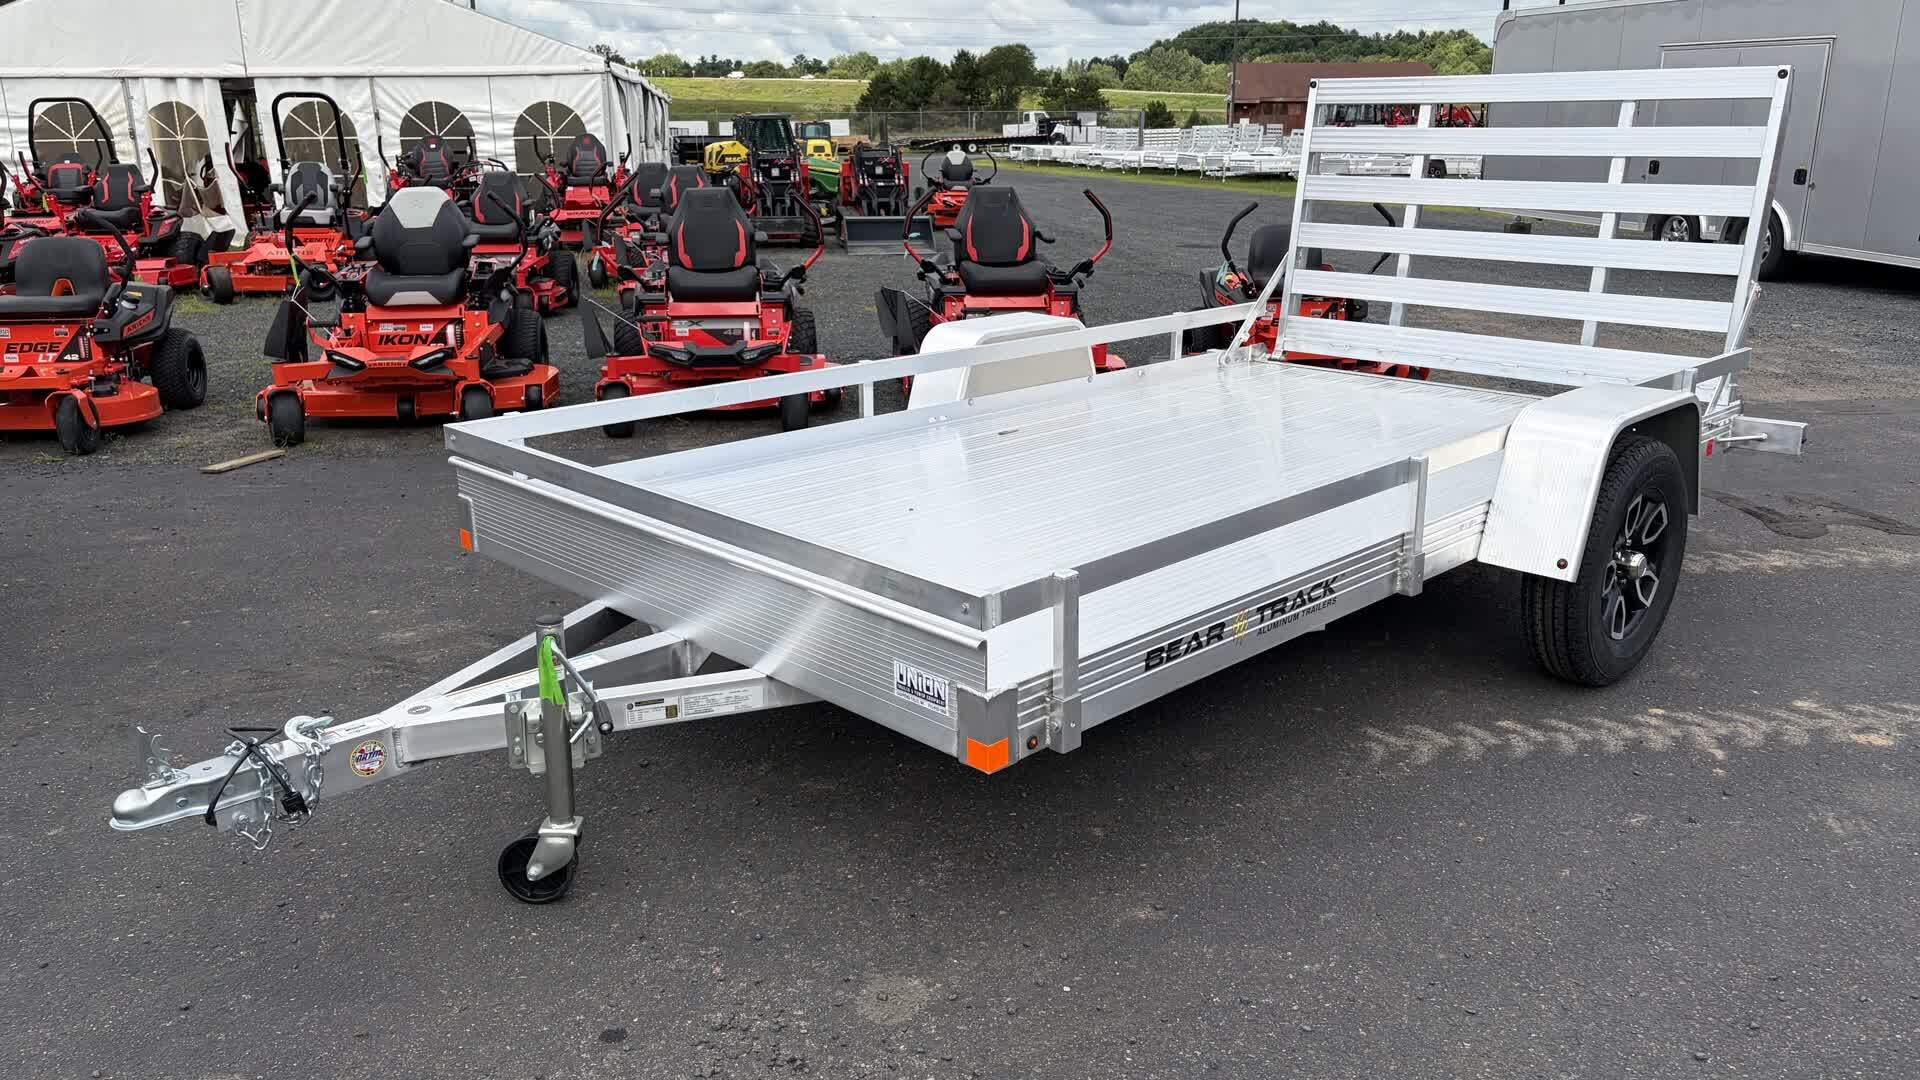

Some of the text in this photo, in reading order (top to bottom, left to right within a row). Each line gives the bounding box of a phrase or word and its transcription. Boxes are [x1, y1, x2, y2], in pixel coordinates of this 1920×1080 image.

[378, 333, 430, 346] IKON
[5, 342, 62, 353] EDGE
[38, 353, 57, 363] LT
[1144, 575, 1337, 672] BEAR TRACK
[1256, 597, 1337, 637] ALUMINUM TRAILERS
